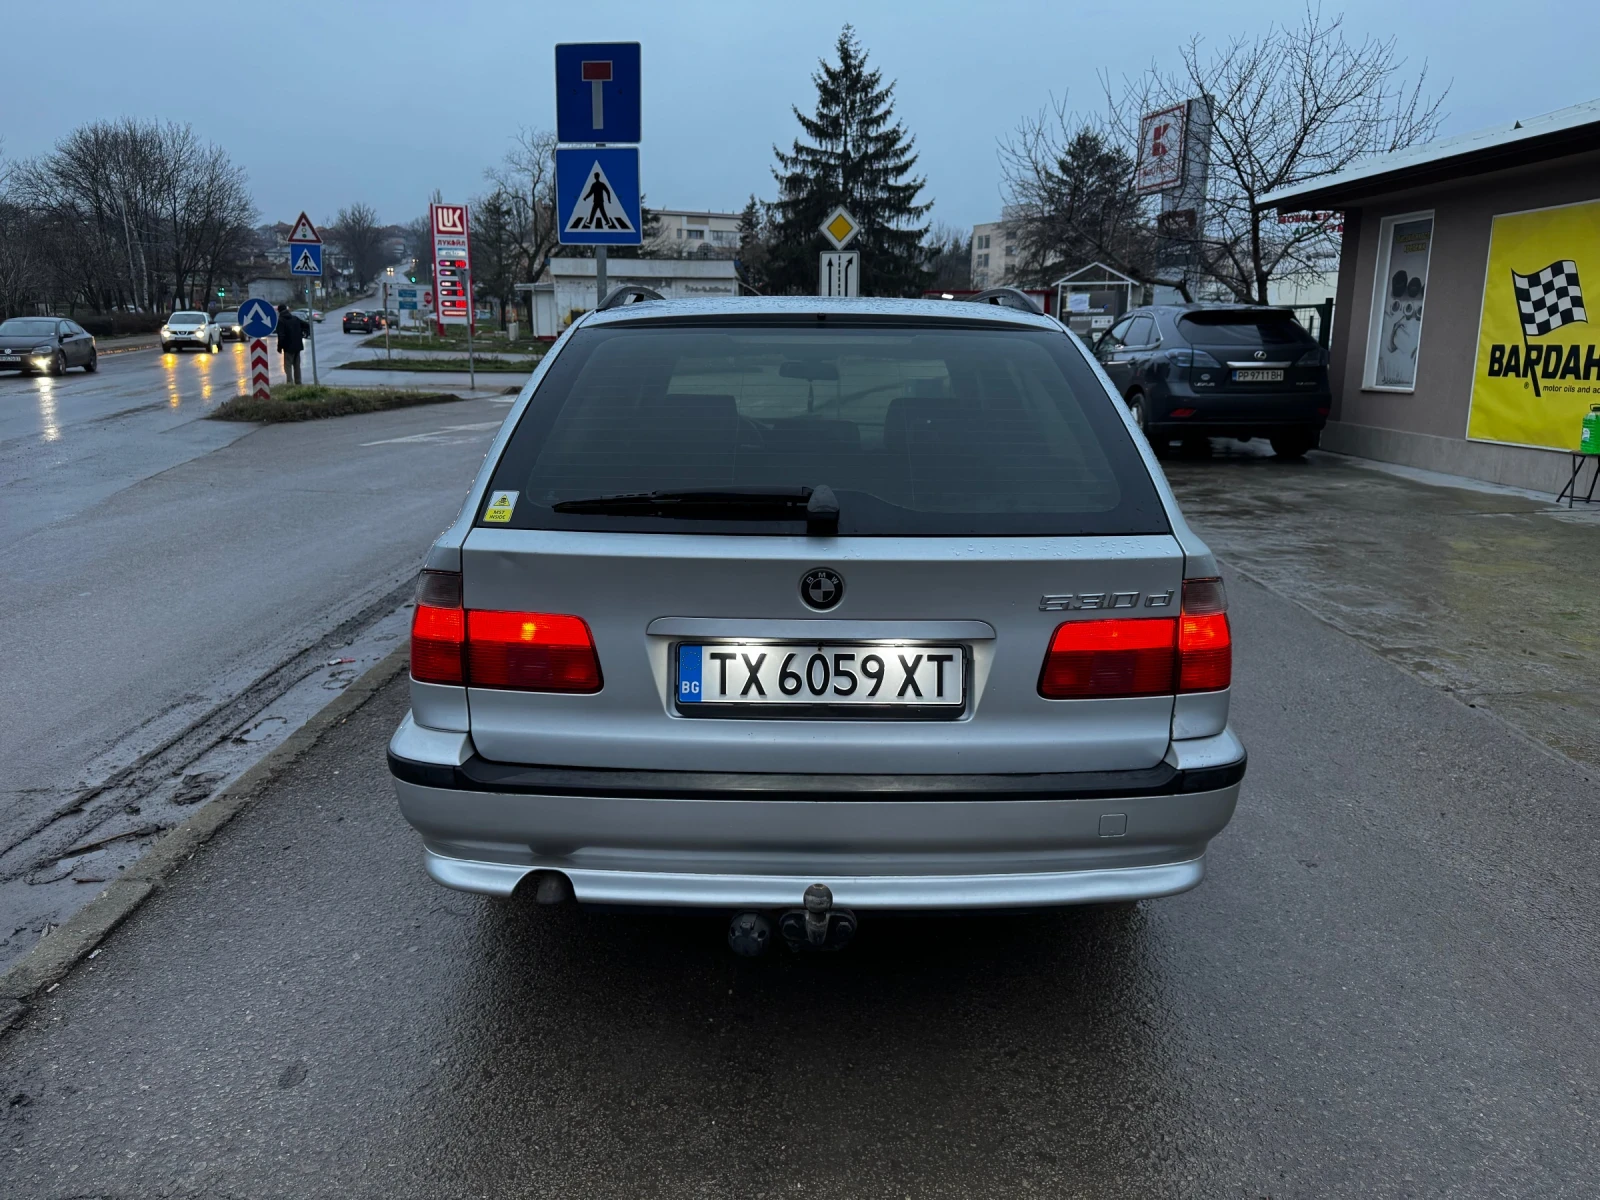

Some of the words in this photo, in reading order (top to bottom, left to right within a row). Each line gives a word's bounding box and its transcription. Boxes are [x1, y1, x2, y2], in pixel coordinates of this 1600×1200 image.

[1238, 371, 1249, 380] PP
[1250, 371, 1270, 380] 9711
[1563, 385, 1576, 393] oils
[1577, 386, 1591, 394] and
[806, 572, 840, 585] BMW
[681, 681, 700, 695] BG
[710, 652, 767, 696] TX
[778, 653, 885, 697] 6059
[896, 655, 954, 697] XT
